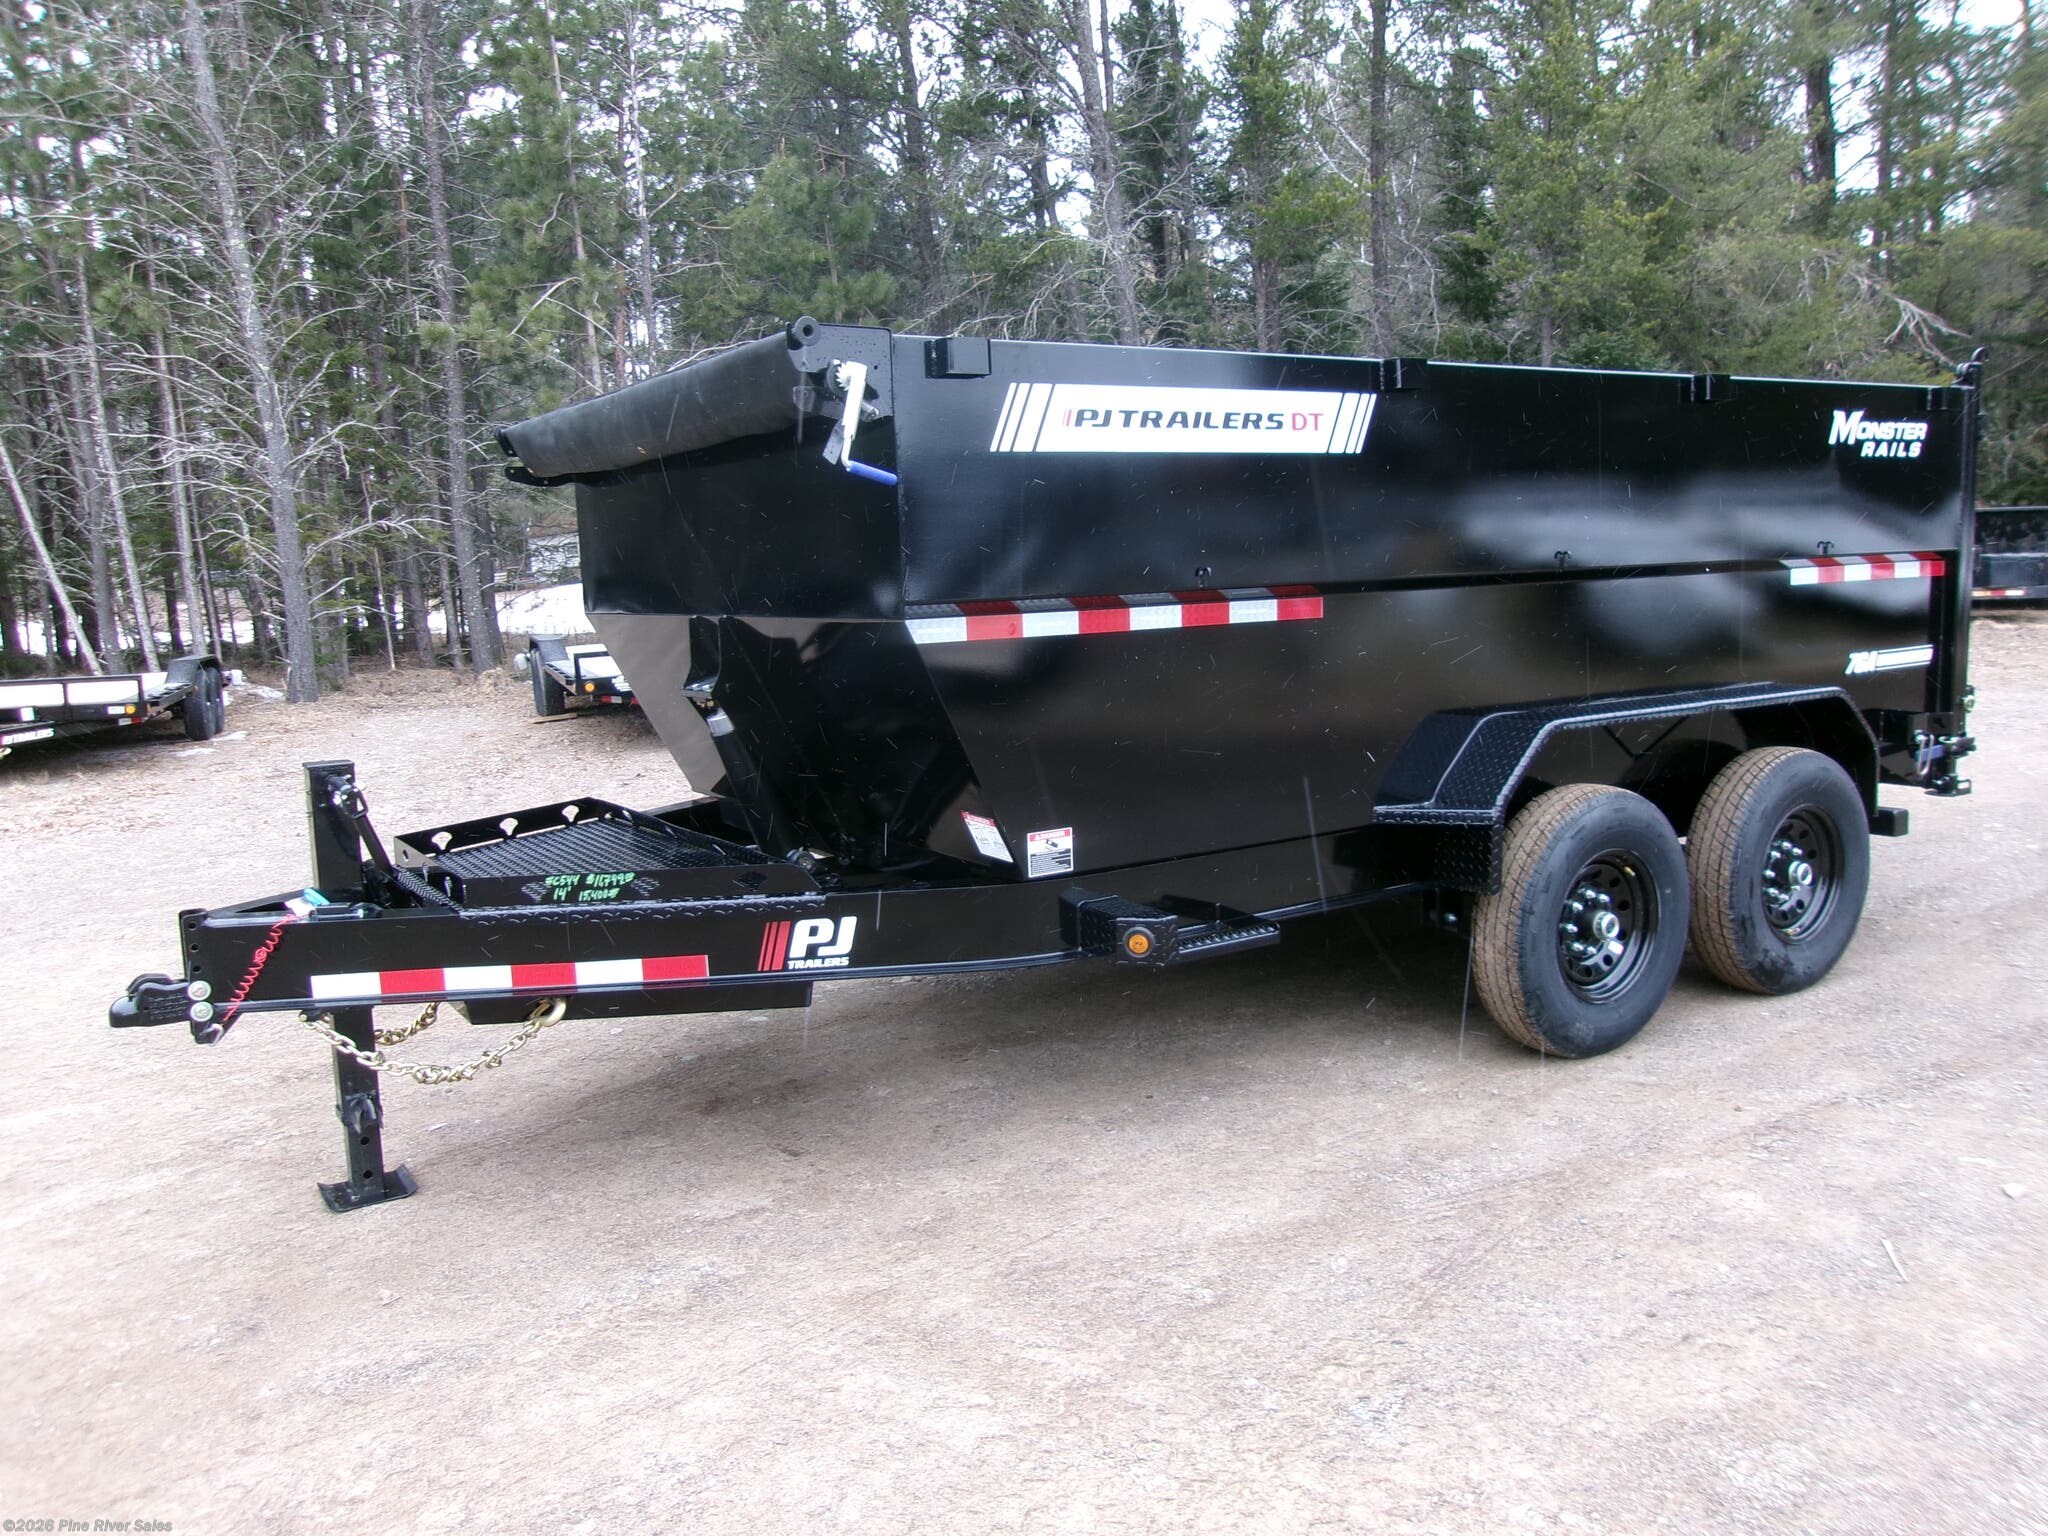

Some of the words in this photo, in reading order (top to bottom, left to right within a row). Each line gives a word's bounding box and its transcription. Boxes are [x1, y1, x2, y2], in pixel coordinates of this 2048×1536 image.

[1074, 408, 1112, 428] PJ
[1118, 409, 1284, 430] TRAILERS
[1291, 413, 1325, 432] DT
[1828, 409, 1928, 445] MONSTER
[1860, 440, 1922, 458] RAILS
[788, 916, 858, 959] PJ
[787, 956, 850, 970] TRAILERS
